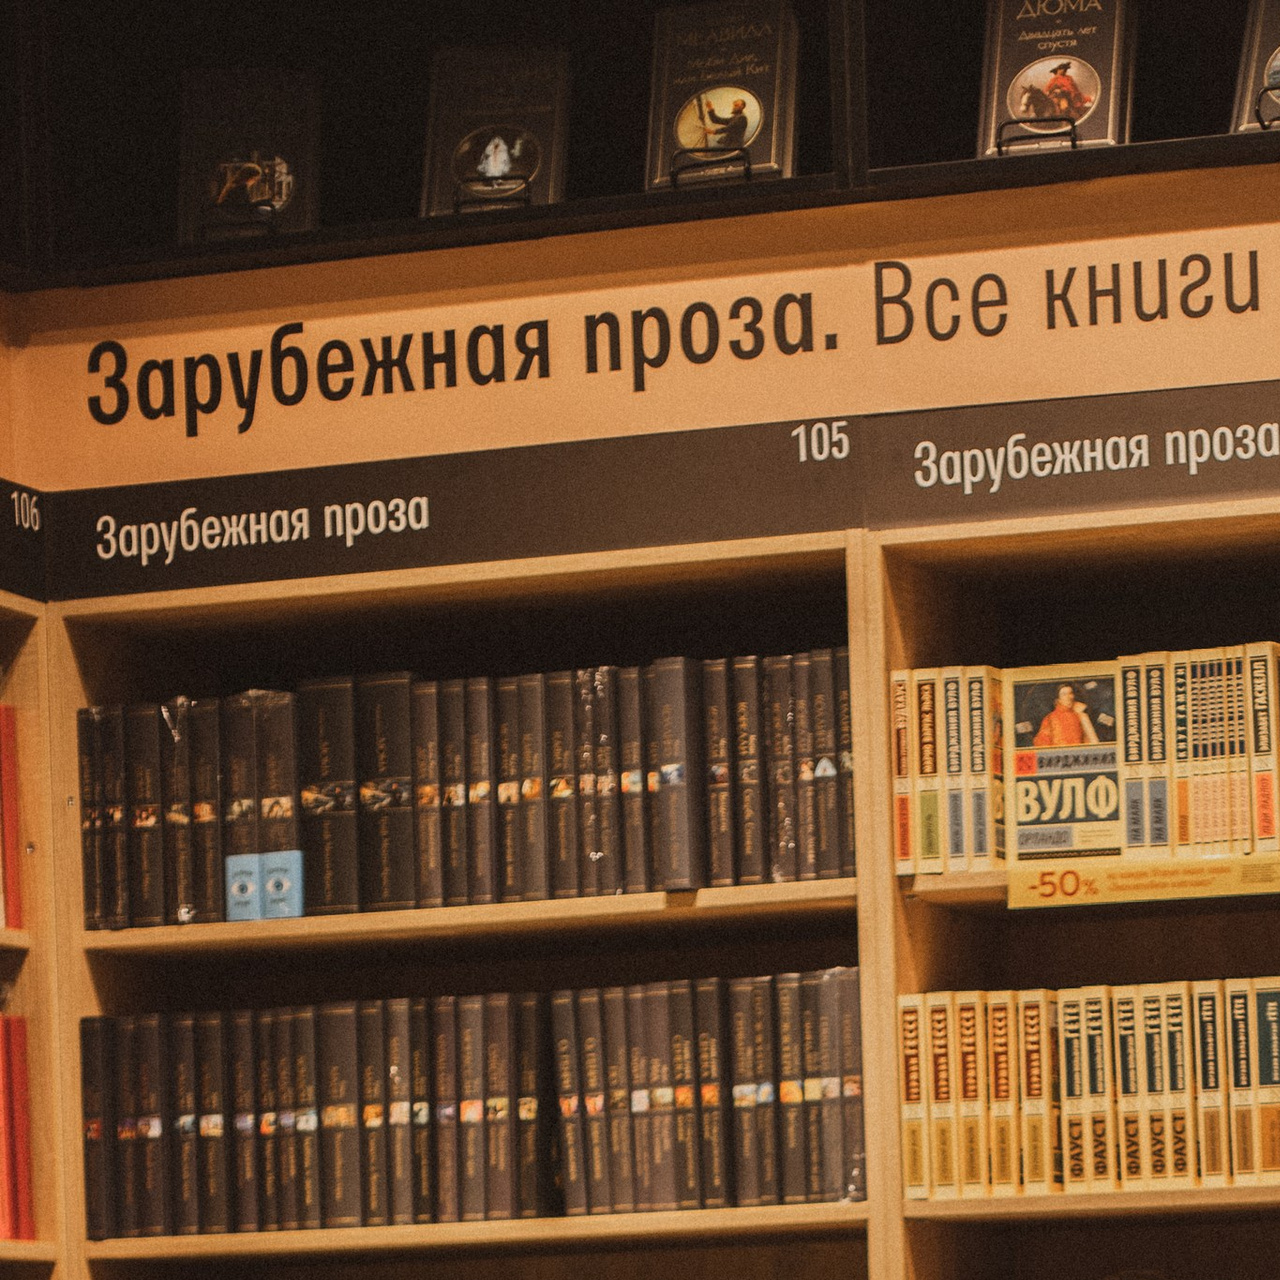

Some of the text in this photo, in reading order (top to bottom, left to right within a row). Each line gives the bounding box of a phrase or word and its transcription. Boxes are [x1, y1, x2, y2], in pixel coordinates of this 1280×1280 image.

[88, 322, 551, 437] Зарубежная
[586, 290, 839, 392] проза.
[874, 260, 1008, 346] Все
[1045, 249, 1260, 330] книги
[791, 420, 850, 463] 105
[914, 420, 1280, 495] Зарубежная проза
[10, 491, 40, 532] 106
[95, 495, 430, 566] Зарубежная проза
[1150, 670, 1163, 760] ВИРДЖИНИЯ ВУЛФ
[1253, 661, 1267, 710] ГАСКЕЛЛ
[946, 682, 961, 772] ВИРДЖИНИЯ ВУЛФ
[970, 682, 984, 771] ВИРДЖИНИЯ ВУЛФ
[1126, 670, 1140, 761] ВИРДЖИНИЯ ВУЛФ
[1016, 775, 1118, 822] ВУЛФ
[1068, 1118, 1084, 1178] ФАУСТ
[1092, 1116, 1108, 1175] ФАУСТ
[1124, 1116, 1141, 1175] ФАУСТ
[1150, 1115, 1165, 1174] ФАУСТ
[1172, 1114, 1187, 1173] ФАУСТ
